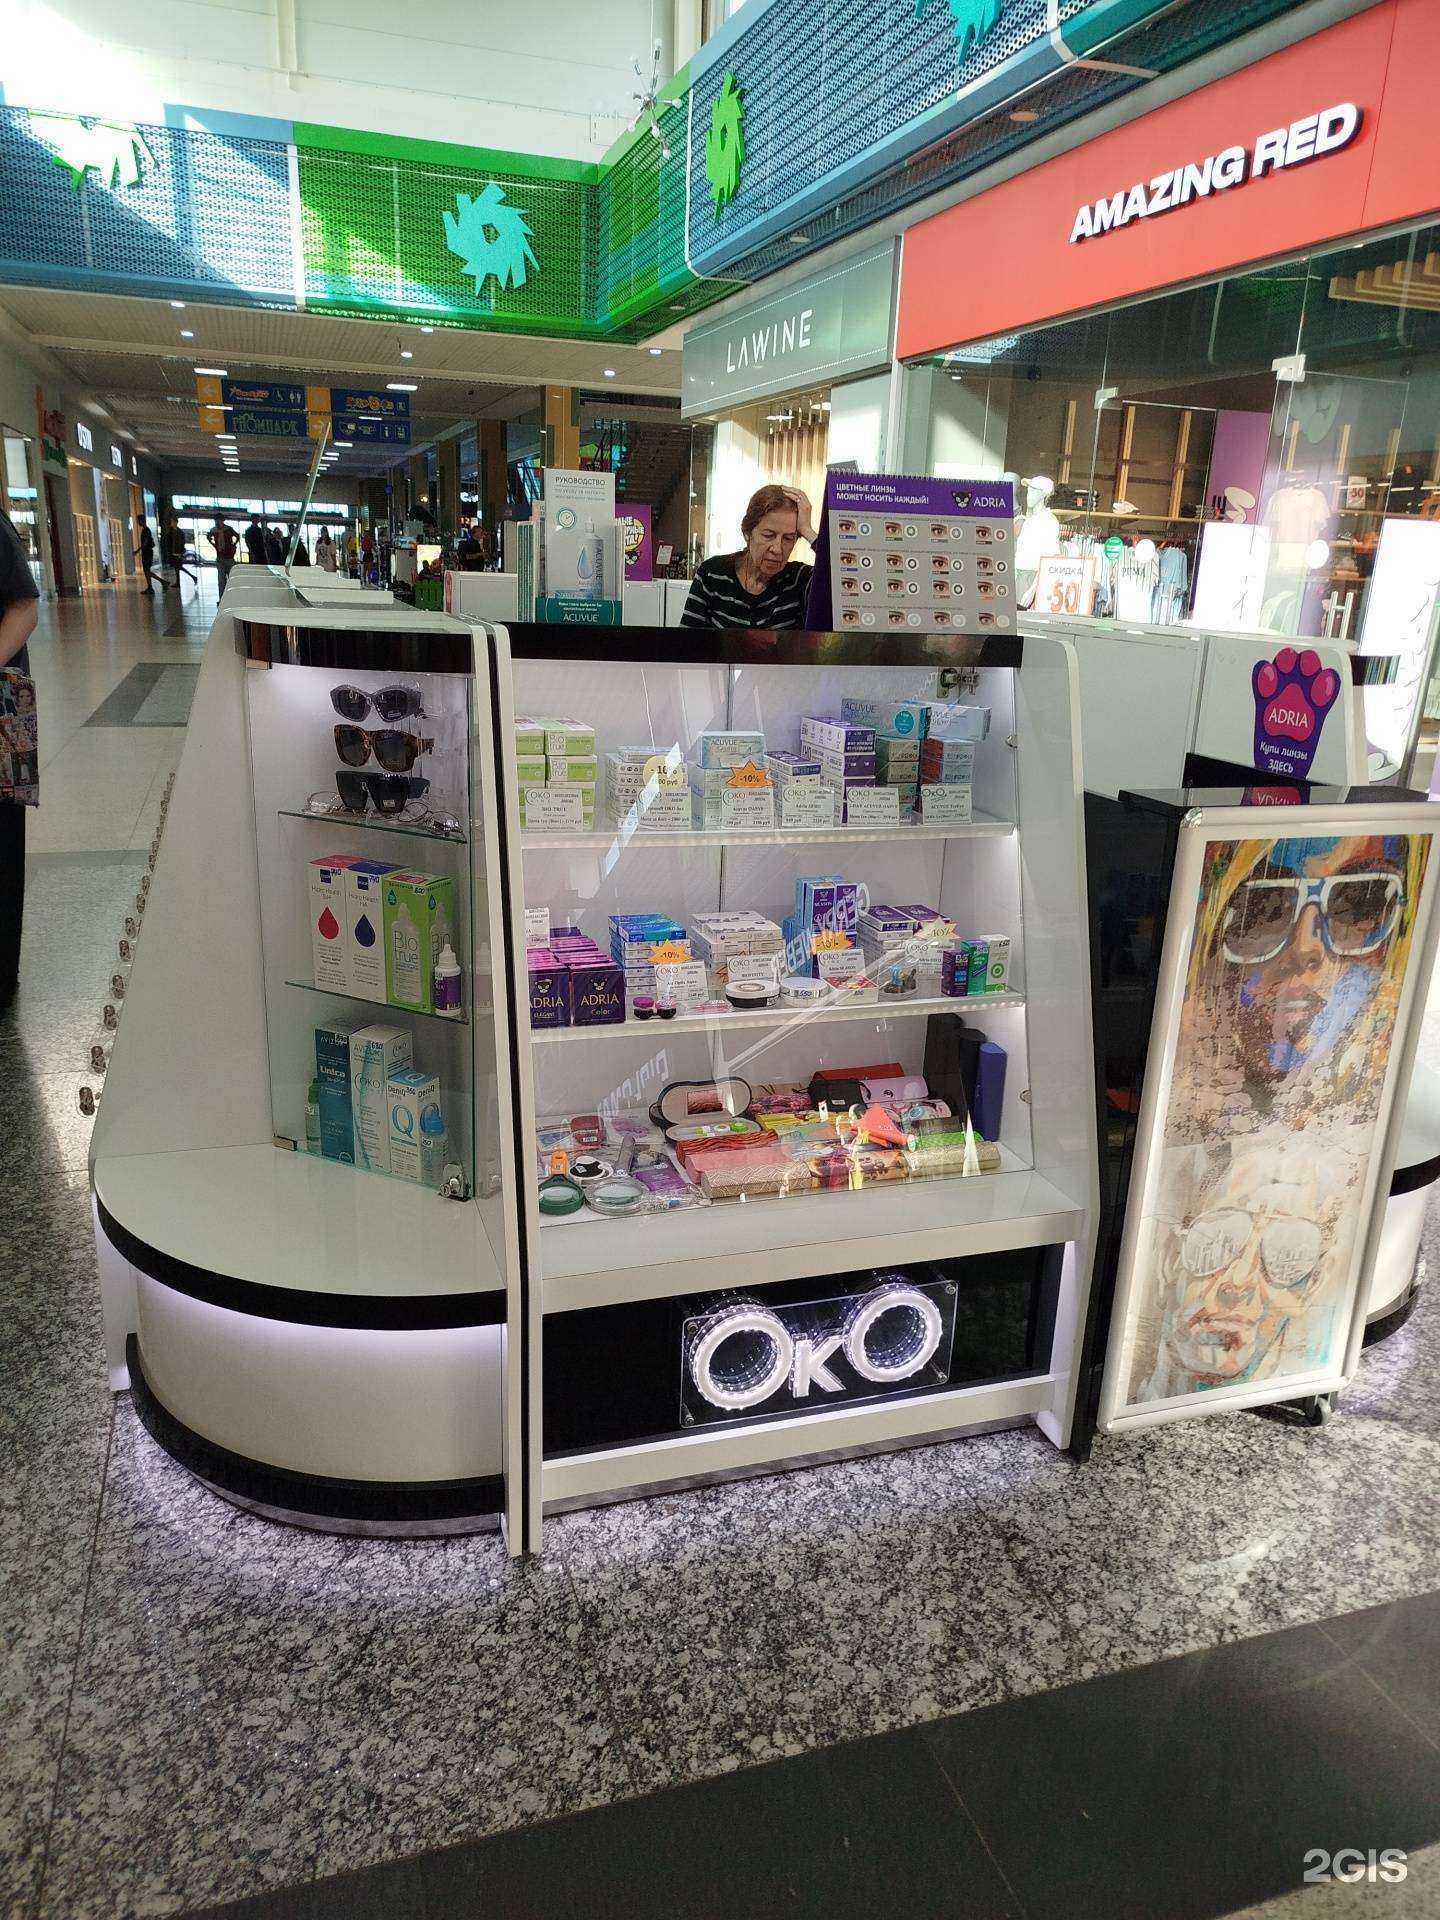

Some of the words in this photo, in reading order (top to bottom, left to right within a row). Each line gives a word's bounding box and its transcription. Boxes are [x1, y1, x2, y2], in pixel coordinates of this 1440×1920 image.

[1069, 145, 1247, 244] AMAZING
[1251, 102, 1360, 177] RED
[726, 308, 813, 374] LAWINE
[555, 476, 606, 486] РУКОВОДСТВО
[836, 483, 870, 492] ЦВЕТНЫЕ
[870, 485, 896, 493] ЛИНЗЫ
[836, 493, 864, 501] МОЖЕТ
[864, 494, 893, 502] НОСИТЬ
[894, 495, 930, 505] КАЖДЫЙ!
[973, 496, 1006, 509] ADRIA
[1047, 566, 1084, 576] СКИДКА
[562, 613, 598, 622] ACUVUE
[844, 703, 876, 713] ACUVUE
[1268, 707, 1309, 729] ADRIA
[1259, 741, 1280, 755] Купи
[1280, 747, 1308, 760] линзы
[1267, 758, 1294, 774] ЗДЕСЬ
[740, 773, 760, 783] -10%
[660, 951, 680, 960] -10%
[580, 993, 620, 1007] ADRIA
[591, 1007, 612, 1016] Color
